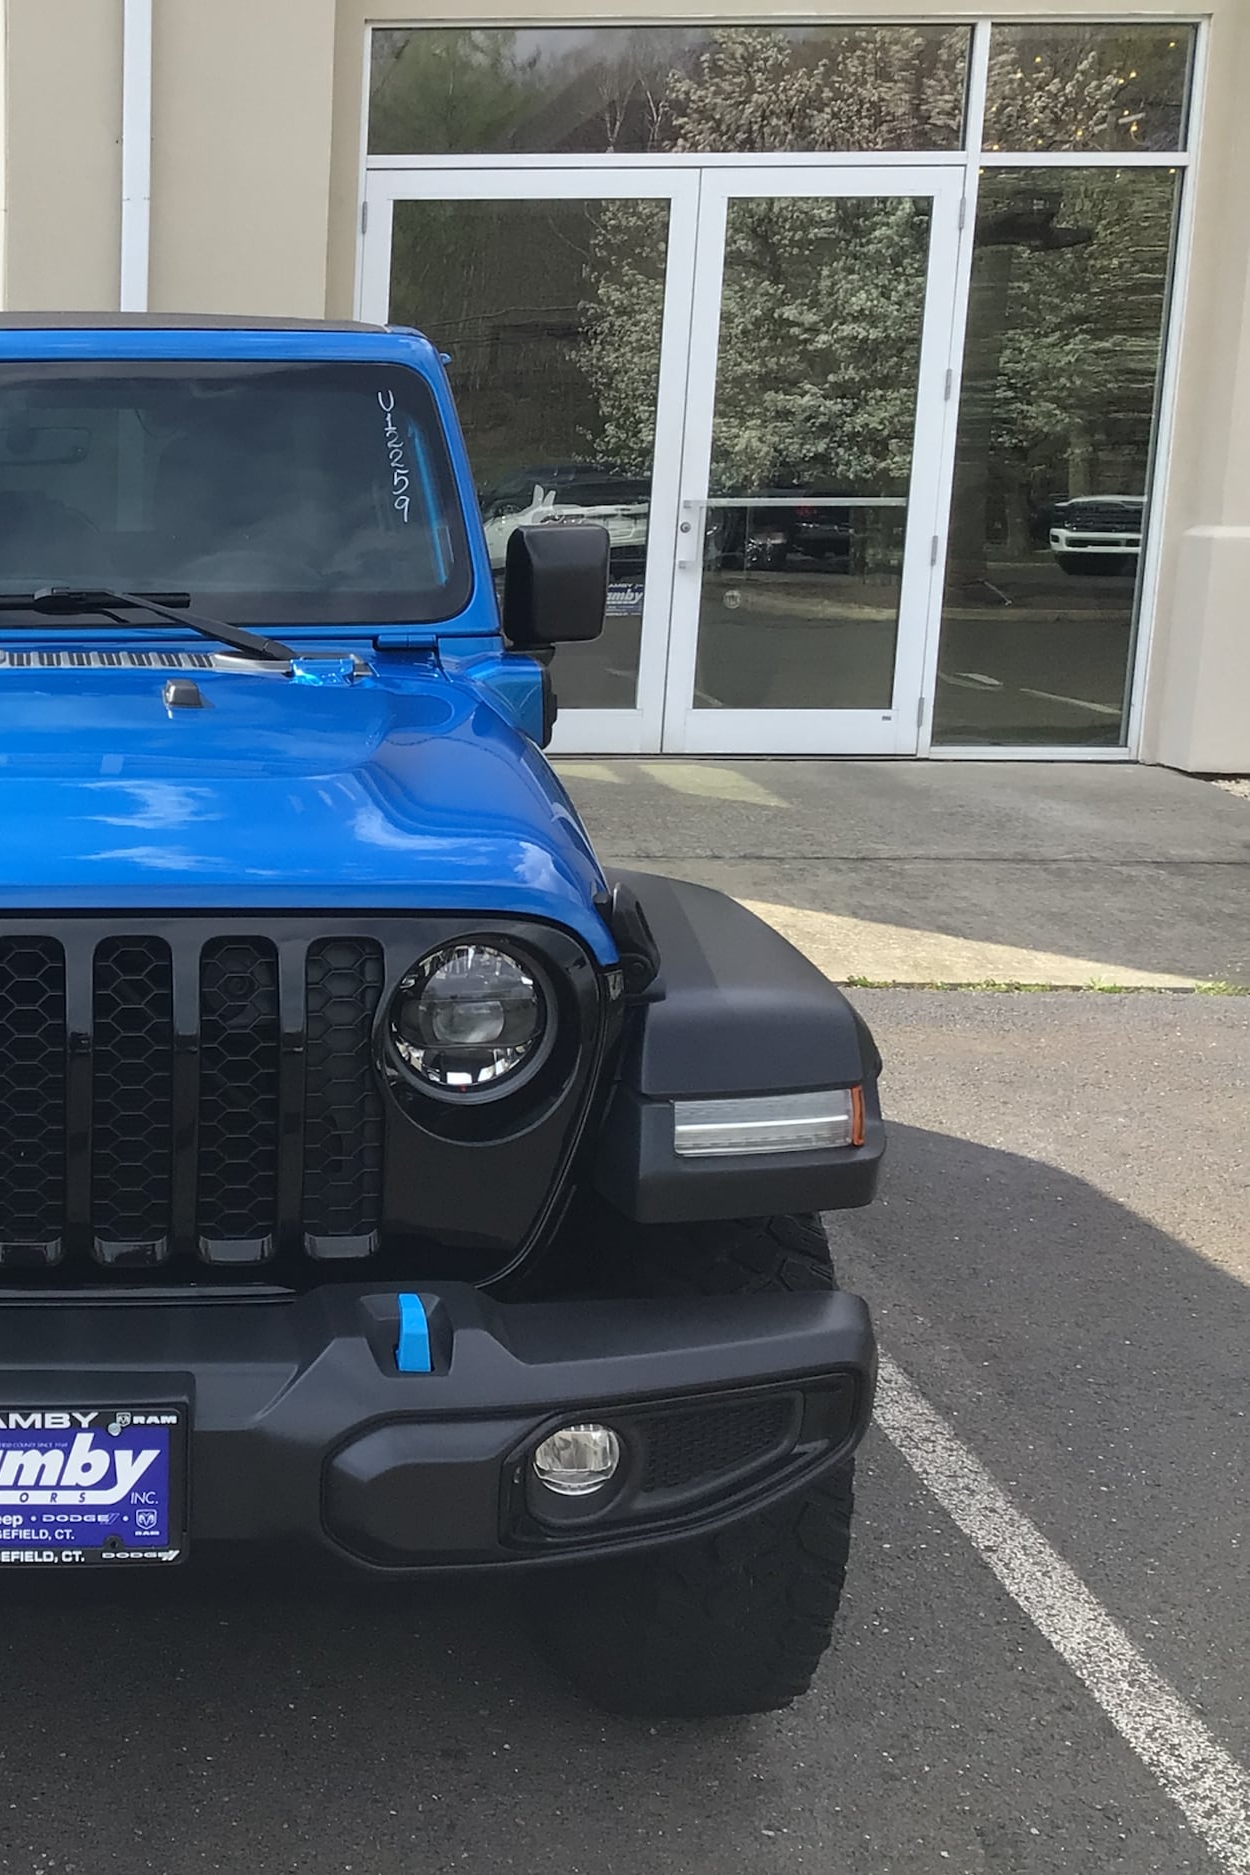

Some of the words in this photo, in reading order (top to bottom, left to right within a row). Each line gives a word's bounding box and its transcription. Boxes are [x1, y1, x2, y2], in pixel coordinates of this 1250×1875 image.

[132, 1415, 177, 1425] RAM
[130, 1491, 159, 1505] INC.
[42, 1514, 110, 1523] DODGE
[54, 1529, 75, 1540] CT.
[61, 1550, 85, 1562] CT.
[102, 1551, 167, 1560] DODGE
